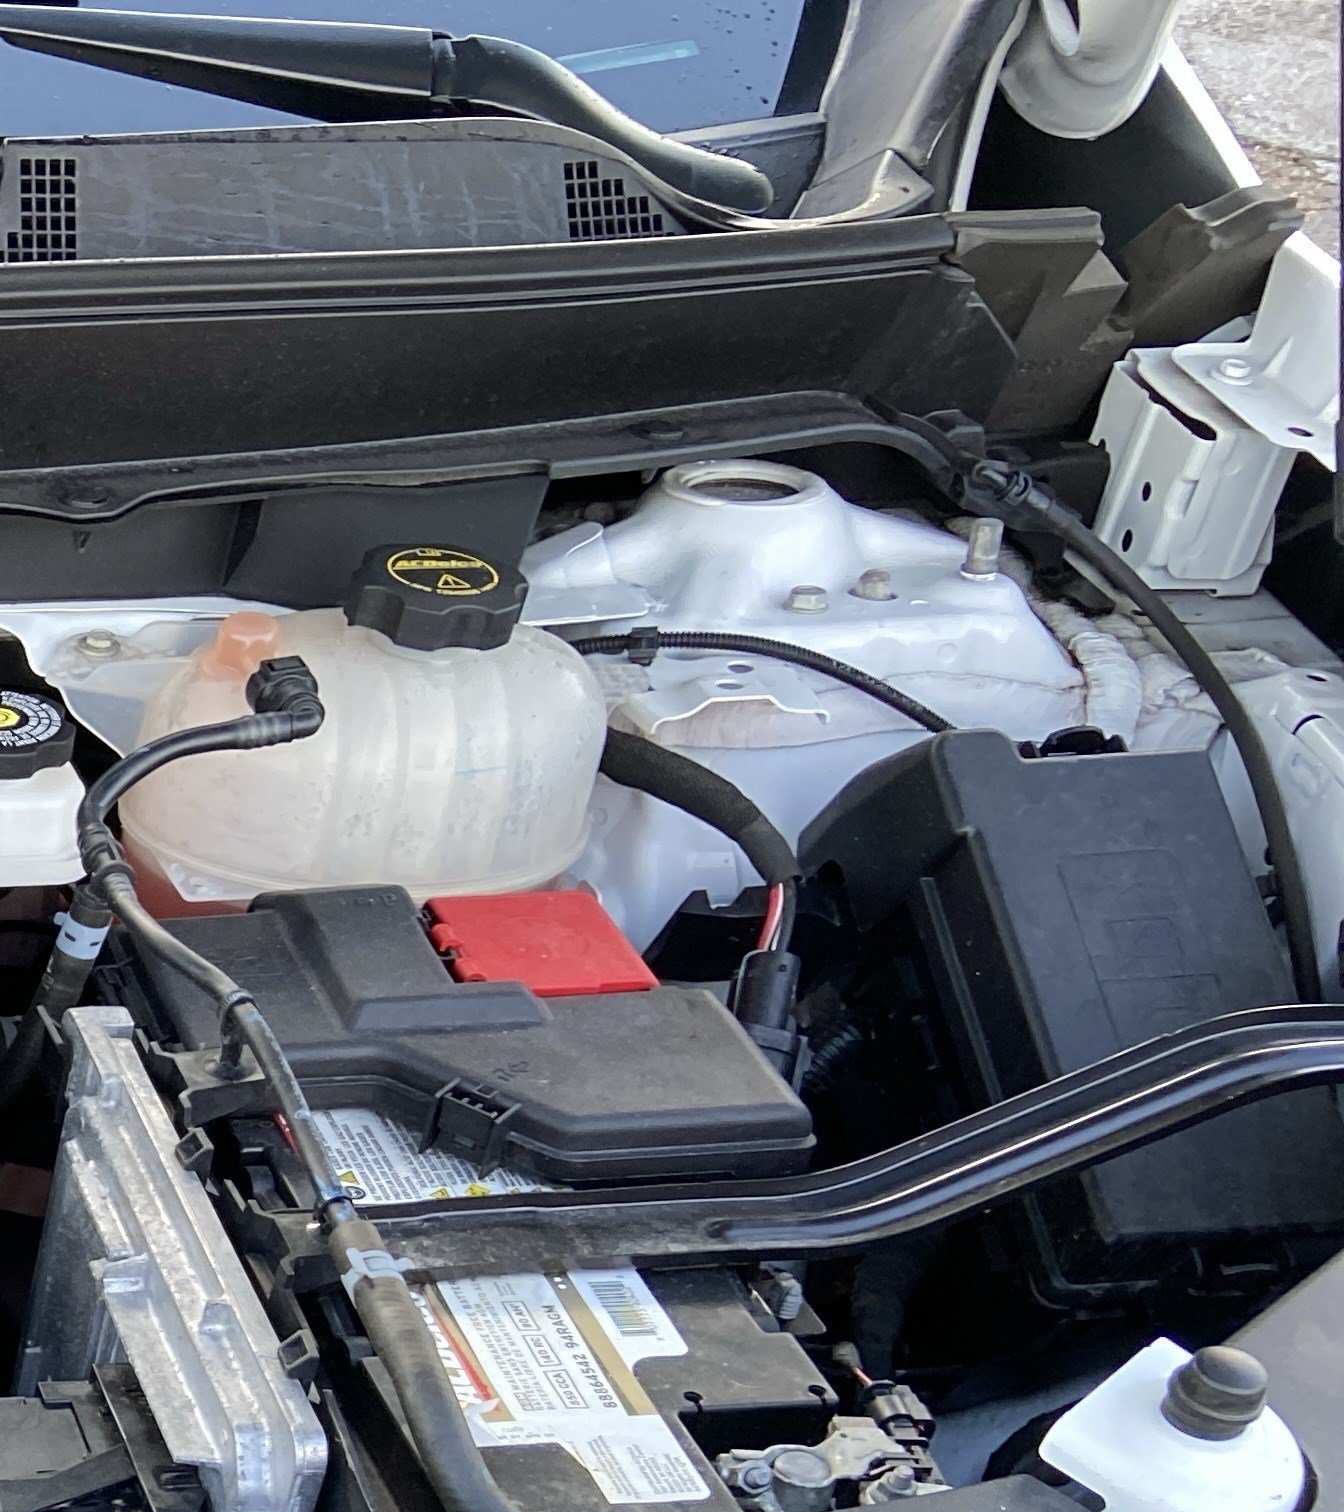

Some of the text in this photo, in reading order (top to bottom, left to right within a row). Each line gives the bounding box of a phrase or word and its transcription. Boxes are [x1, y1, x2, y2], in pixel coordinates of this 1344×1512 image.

[447, 1279, 472, 1309] BATTER
[466, 1312, 485, 1330] FREE
[540, 1304, 579, 1348] 94RAGM
[529, 1336, 544, 1347] RC
[478, 1333, 520, 1389] MAINTENANCE
[537, 1349, 554, 1362] 140
[551, 1372, 570, 1388] CCA
[571, 1353, 618, 1407] 88864542
